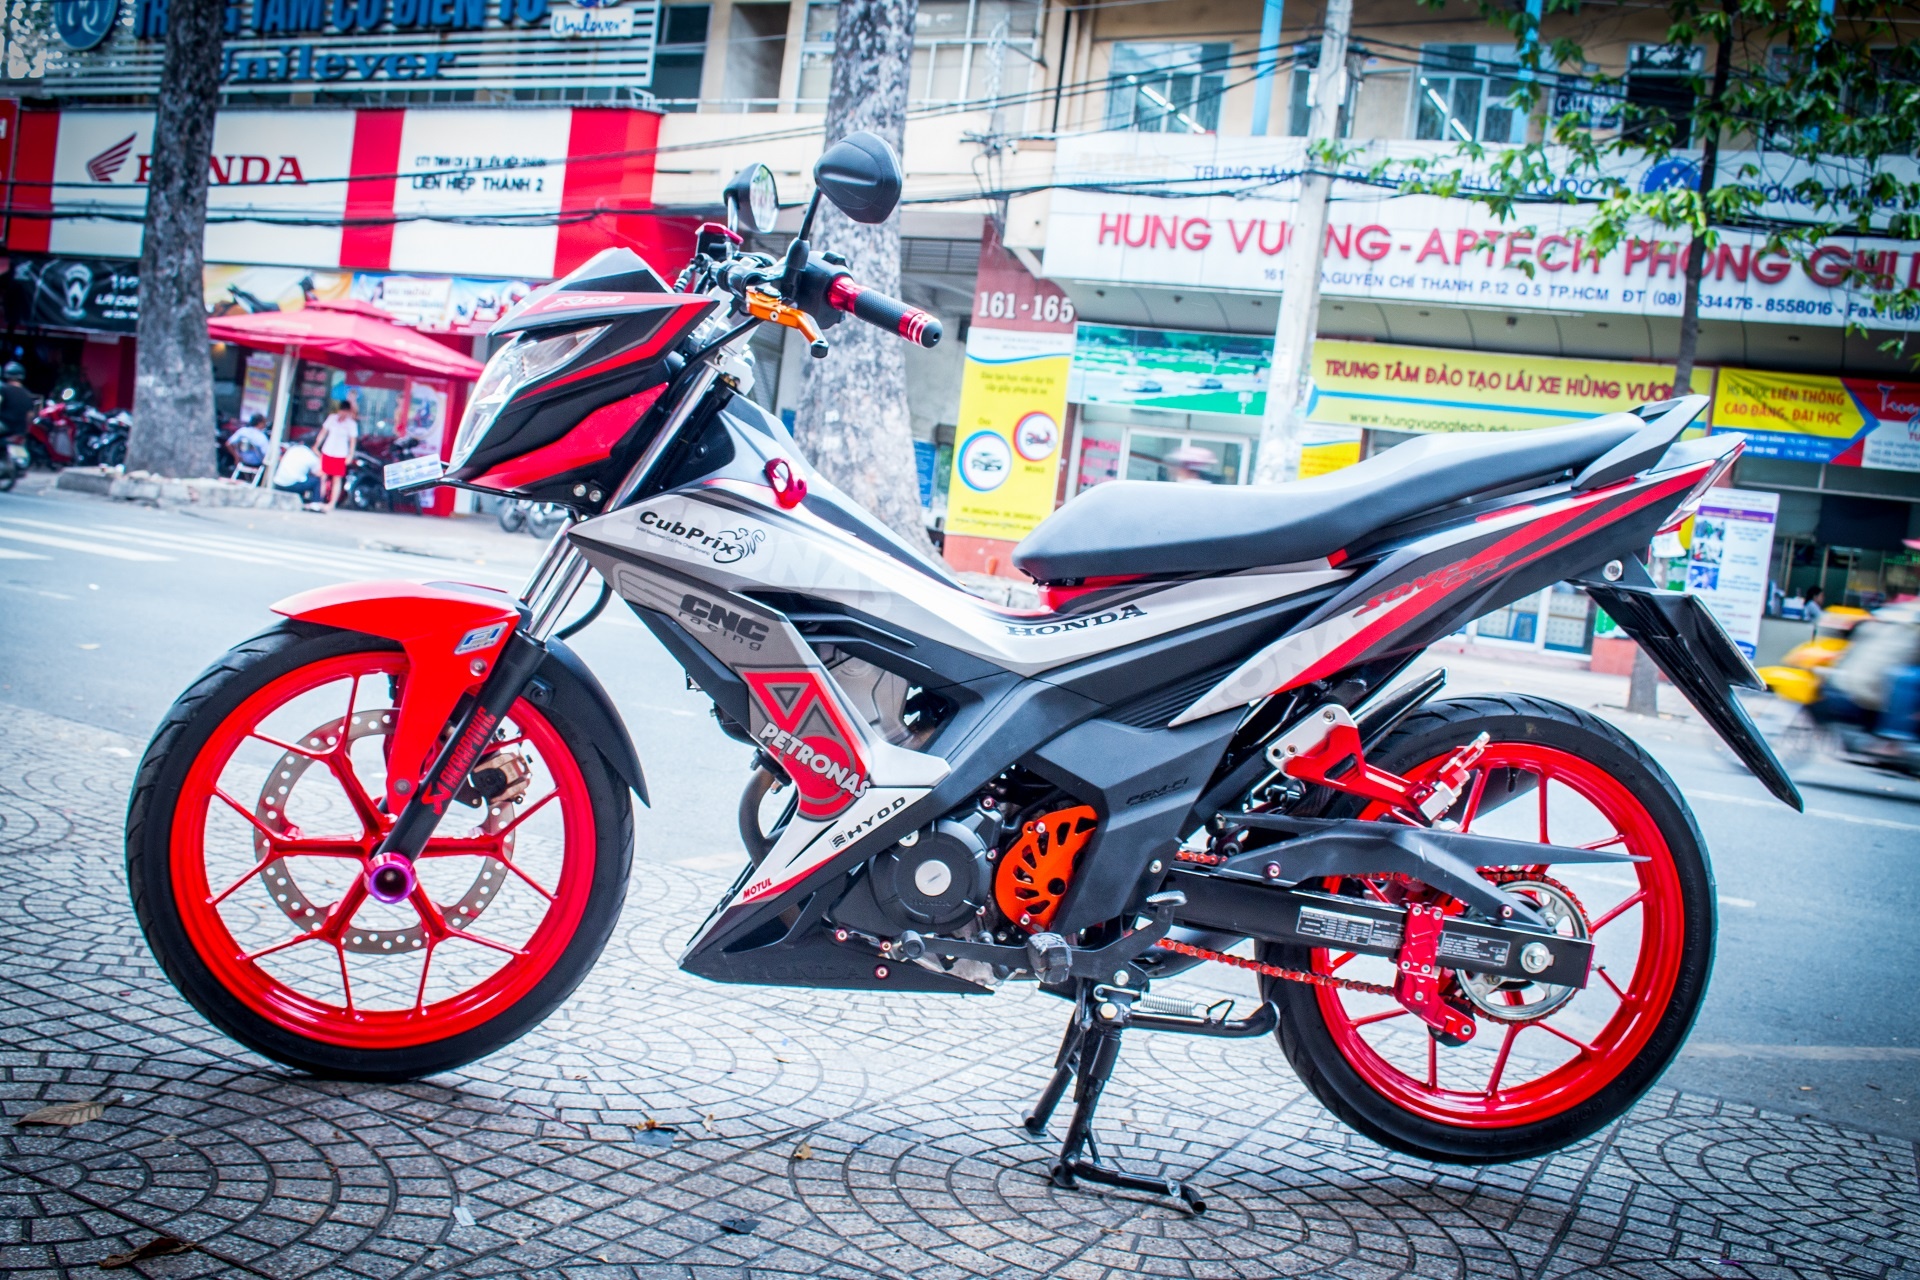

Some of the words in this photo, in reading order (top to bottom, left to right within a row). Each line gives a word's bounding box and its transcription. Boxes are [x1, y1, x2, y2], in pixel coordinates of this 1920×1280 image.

[135, 154, 308, 185] HNDA
[536, 179, 543, 191] 2
[1516, 284, 1528, 297] Q
[1532, 284, 1541, 296] 5
[1765, 300, 1833, 316] 8558016
[1325, 359, 1379, 379] TRUNG
[1385, 361, 1419, 383] TÂM
[1468, 371, 1500, 392] TẠO
[1506, 370, 1533, 393] LÁI
[1537, 376, 1562, 395] XE
[1566, 373, 1620, 399] HÙNG
[1723, 402, 1748, 415] CAO
[640, 511, 737, 555] CubPrix
[678, 611, 762, 652] racing
[680, 593, 769, 642] CNC
[1005, 603, 1148, 638] HONDA
[760, 722, 871, 798] PETRONAS
[847, 796, 906, 840] HYOD
[743, 878, 772, 900] MOTUL
